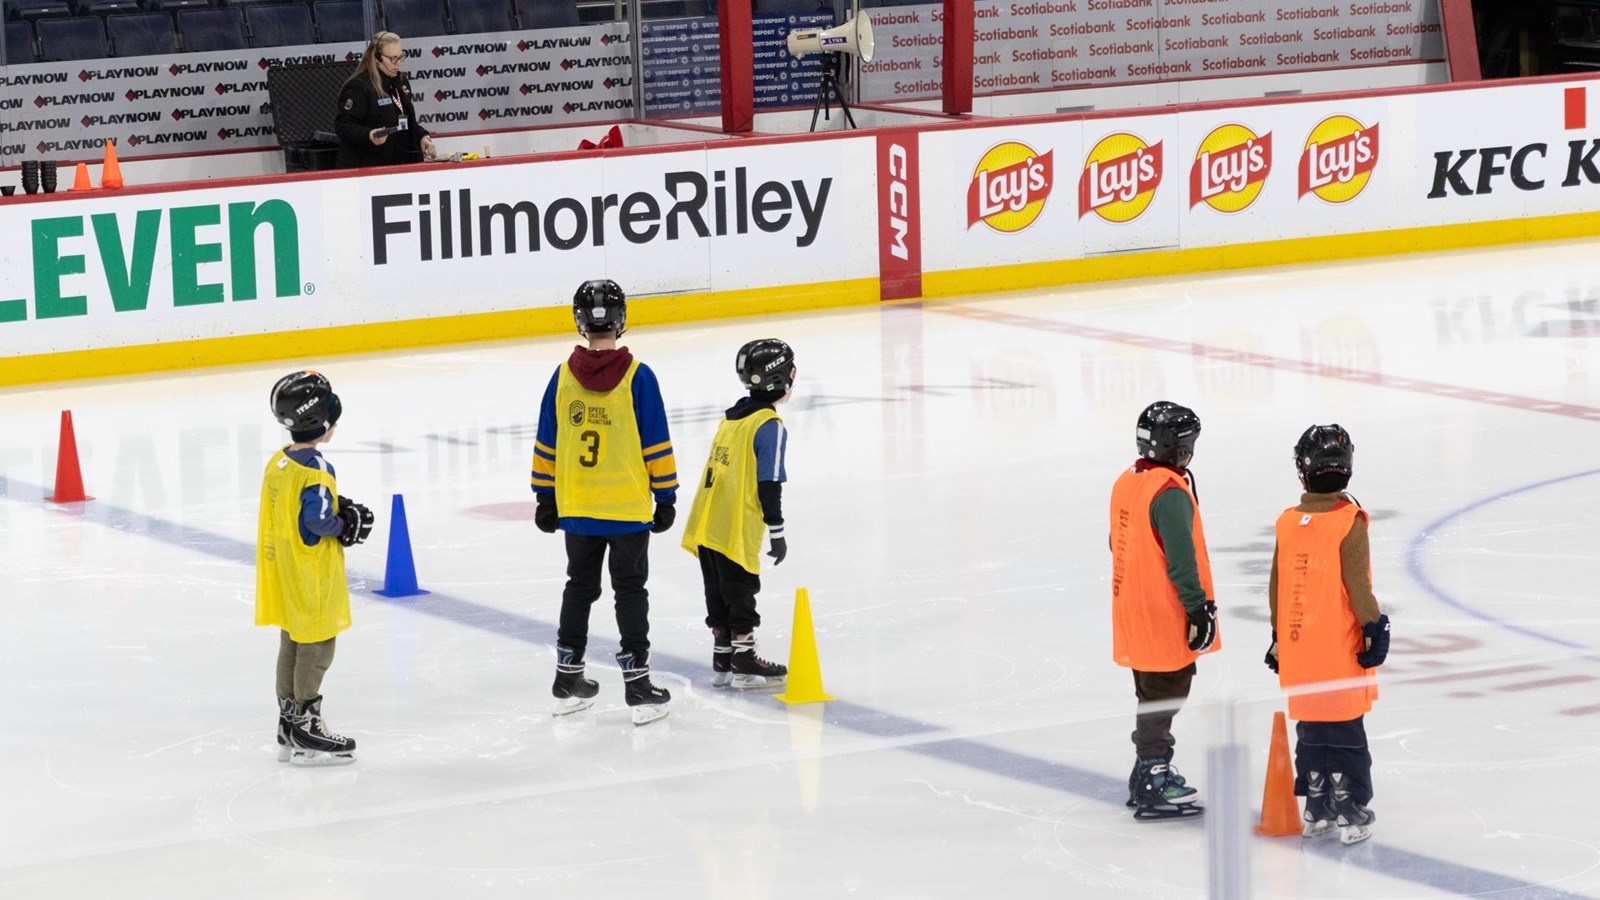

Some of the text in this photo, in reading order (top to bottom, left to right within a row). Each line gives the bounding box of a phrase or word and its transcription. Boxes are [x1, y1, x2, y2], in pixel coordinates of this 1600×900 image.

[871, 11, 920, 26] tiabank
[1010, 2, 1076, 16] Scotiabank
[974, 26, 1038, 42] Scotiabank
[1050, 20, 1115, 36] Scotiabank
[1126, 15, 1191, 31] Scotiabank
[1202, 10, 1266, 26] Scotiabank
[1276, 6, 1340, 21] Scotiabank
[1350, 0, 1412, 16] Scotiabank
[88, 66, 159, 80] PLAYNOW
[178, 60, 248, 74] PLAYNOW
[440, 43, 507, 56] PLAYNOW
[526, 36, 591, 50] PLAYNOW
[862, 58, 922, 73] cotiabank
[1012, 46, 1078, 62] Scotiabank
[1090, 40, 1154, 56] Scotiabank
[1165, 35, 1230, 51] Scotiabank
[1240, 30, 1303, 46] Scotiabank
[1314, 26, 1376, 41] Scotiabank
[1386, 22, 1441, 36] Scotiaban
[974, 72, 1040, 88] Scotiabank
[1052, 66, 1116, 82] Scotiabank
[1128, 60, 1192, 76] Scotiabank
[1202, 56, 1266, 71] Scotiabank
[1277, 51, 1340, 66] Scotiabank
[1350, 44, 1412, 60] Scotiabank
[0, 118, 70, 132] PLAYNOW
[90, 112, 161, 126] PLAYNOW
[181, 105, 250, 119] PLAYNOW
[444, 86, 510, 100] PLAYNOW
[528, 80, 594, 94] PLAYNOW
[43, 92, 115, 106] PLAYNOW
[134, 86, 205, 100] PLAYNOW
[224, 81, 269, 94] PLAYN
[486, 62, 551, 76] PLAYNOW
[137, 130, 207, 145] PLAYNOW
[227, 126, 277, 138] PLAYN
[418, 112, 468, 124] AYNOW
[488, 105, 553, 119] PLAYNOW
[1090, 147, 1156, 208] Lay's
[1201, 139, 1265, 198] Lay's
[1309, 130, 1372, 186] Lay's
[1427, 142, 1547, 198] KFC
[889, 144, 908, 260] CCM
[979, 157, 1046, 218] Lay's
[371, 166, 833, 265] FillmoreRiley
[0, 198, 301, 322] EVEn
[579, 430, 600, 468] 3
